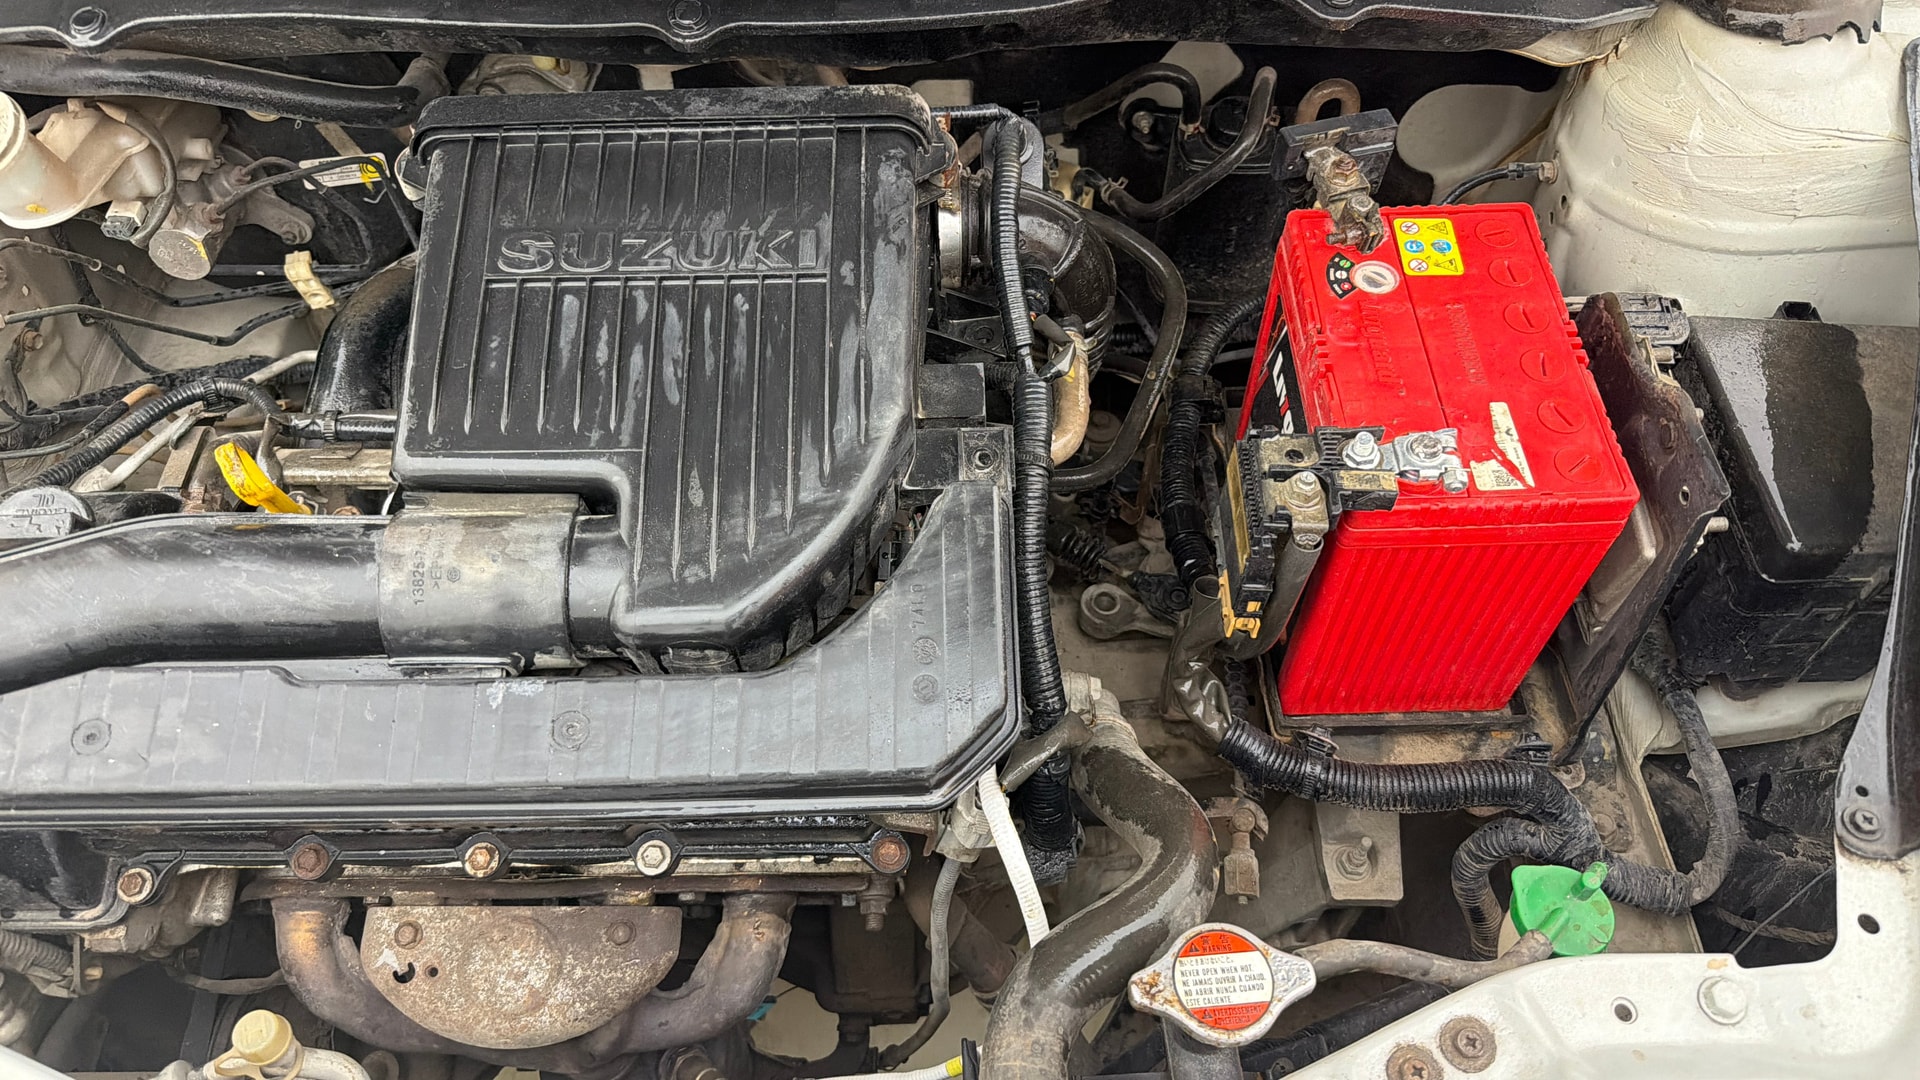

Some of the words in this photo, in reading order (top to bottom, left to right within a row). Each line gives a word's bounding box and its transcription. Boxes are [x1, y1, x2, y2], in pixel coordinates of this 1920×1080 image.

[497, 229, 817, 273] SUZUKI
[1201, 943, 1232, 953] WARNING
[1180, 969, 1200, 978] NEVER
[1202, 967, 1218, 976] OPEN
[1220, 965, 1238, 974] WHEN
[1182, 979, 1190, 987] NE
[1192, 977, 1213, 986] JAMAIS
[1215, 975, 1236, 985] OUVRIR
[1184, 989, 1193, 997] NO
[1195, 987, 1213, 996] ABRIR
[1215, 985, 1237, 994] NUNCA
[1239, 982, 1265, 992] CUANDO
[1186, 998, 1200, 1007] ESTE
